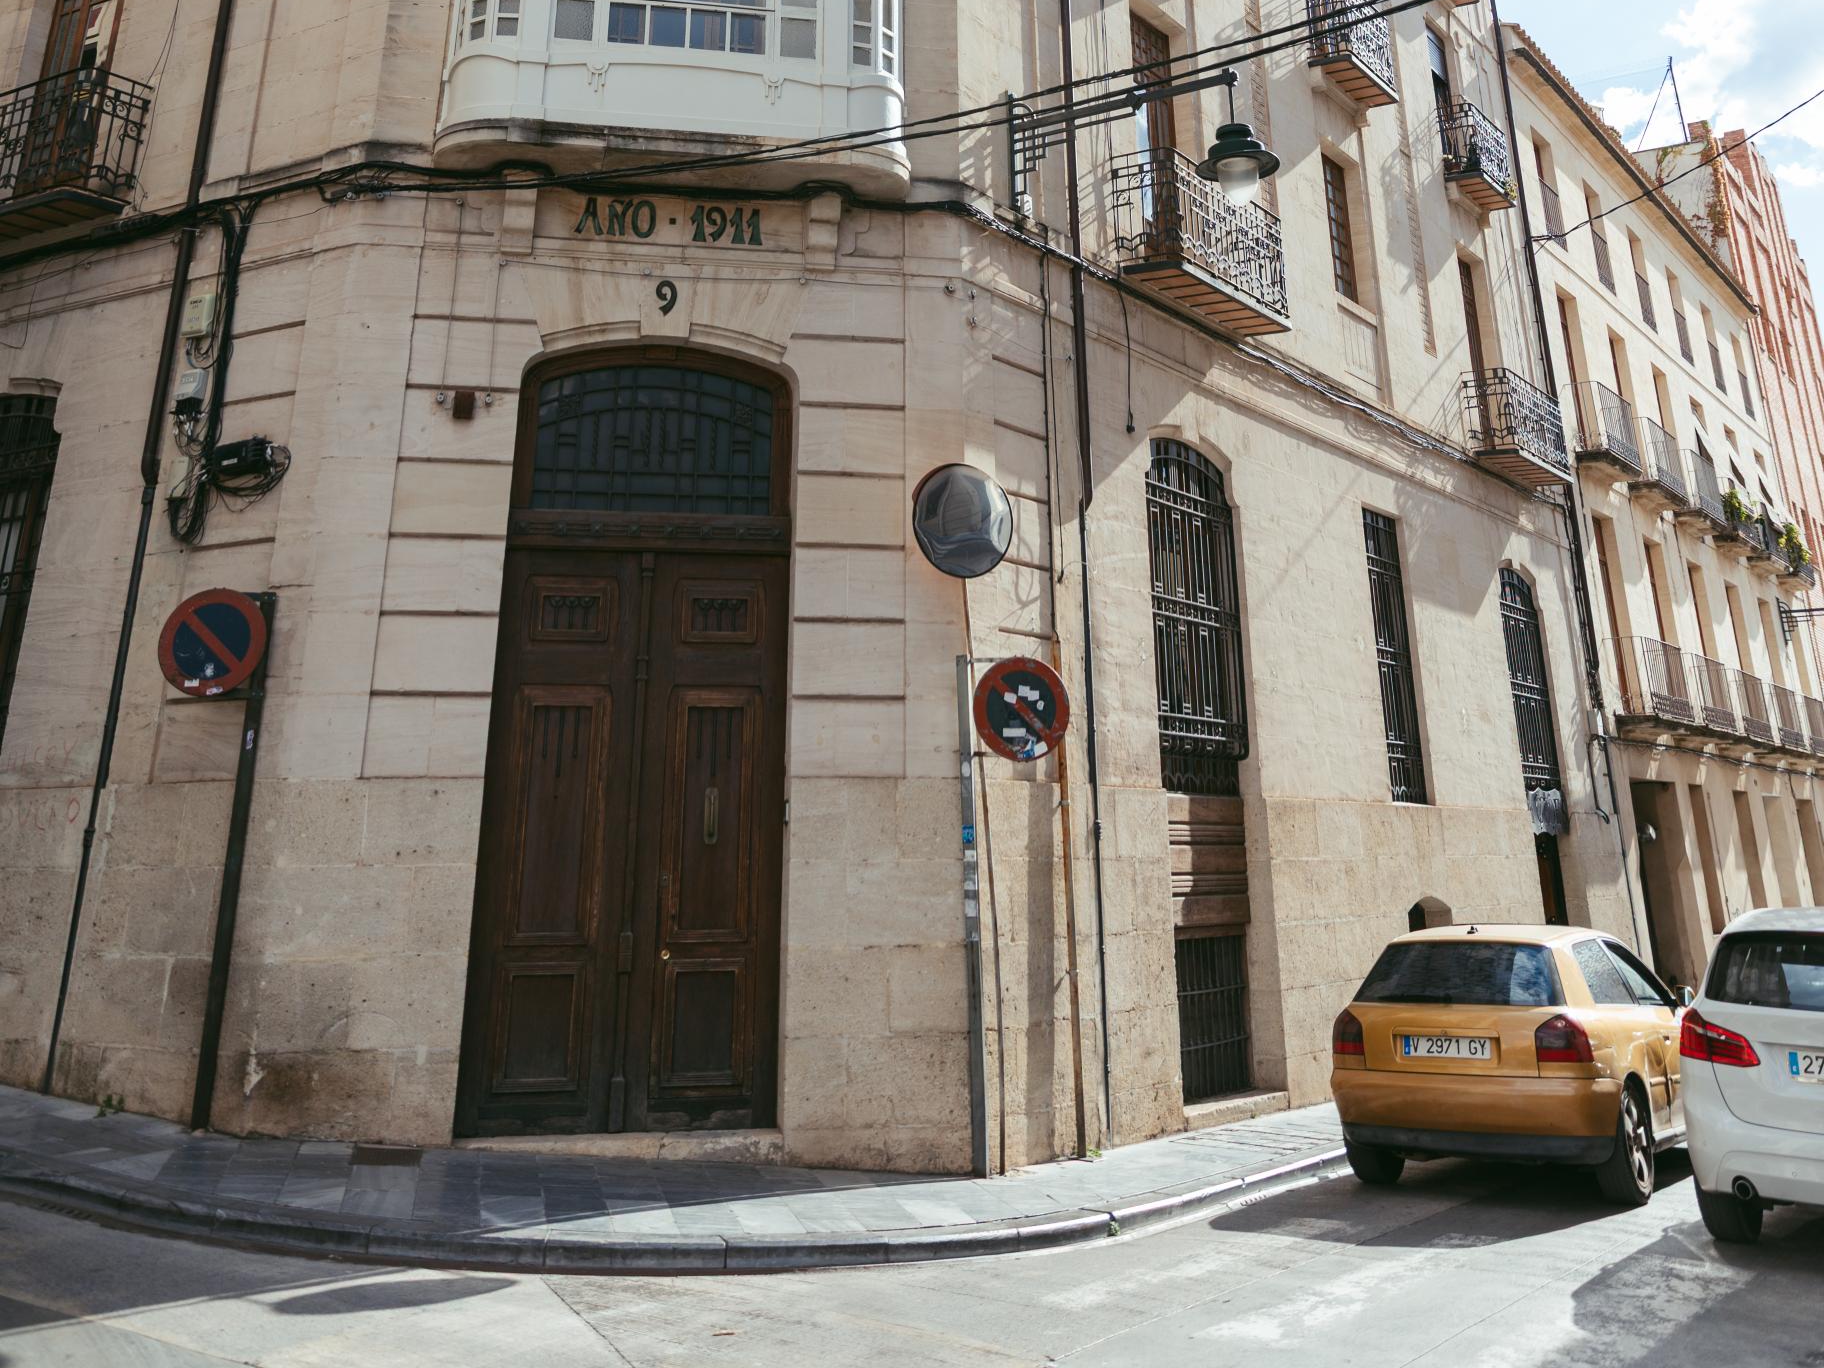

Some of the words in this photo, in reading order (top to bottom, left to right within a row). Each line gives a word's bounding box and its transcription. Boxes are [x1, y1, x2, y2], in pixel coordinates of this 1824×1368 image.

[574, 197, 657, 239] AÑO
[690, 205, 763, 246] 1911
[655, 280, 678, 317] 9
[1412, 1038, 1419, 1053] V
[1426, 1038, 1460, 1055] 2971
[1468, 1040, 1487, 1057] GY
